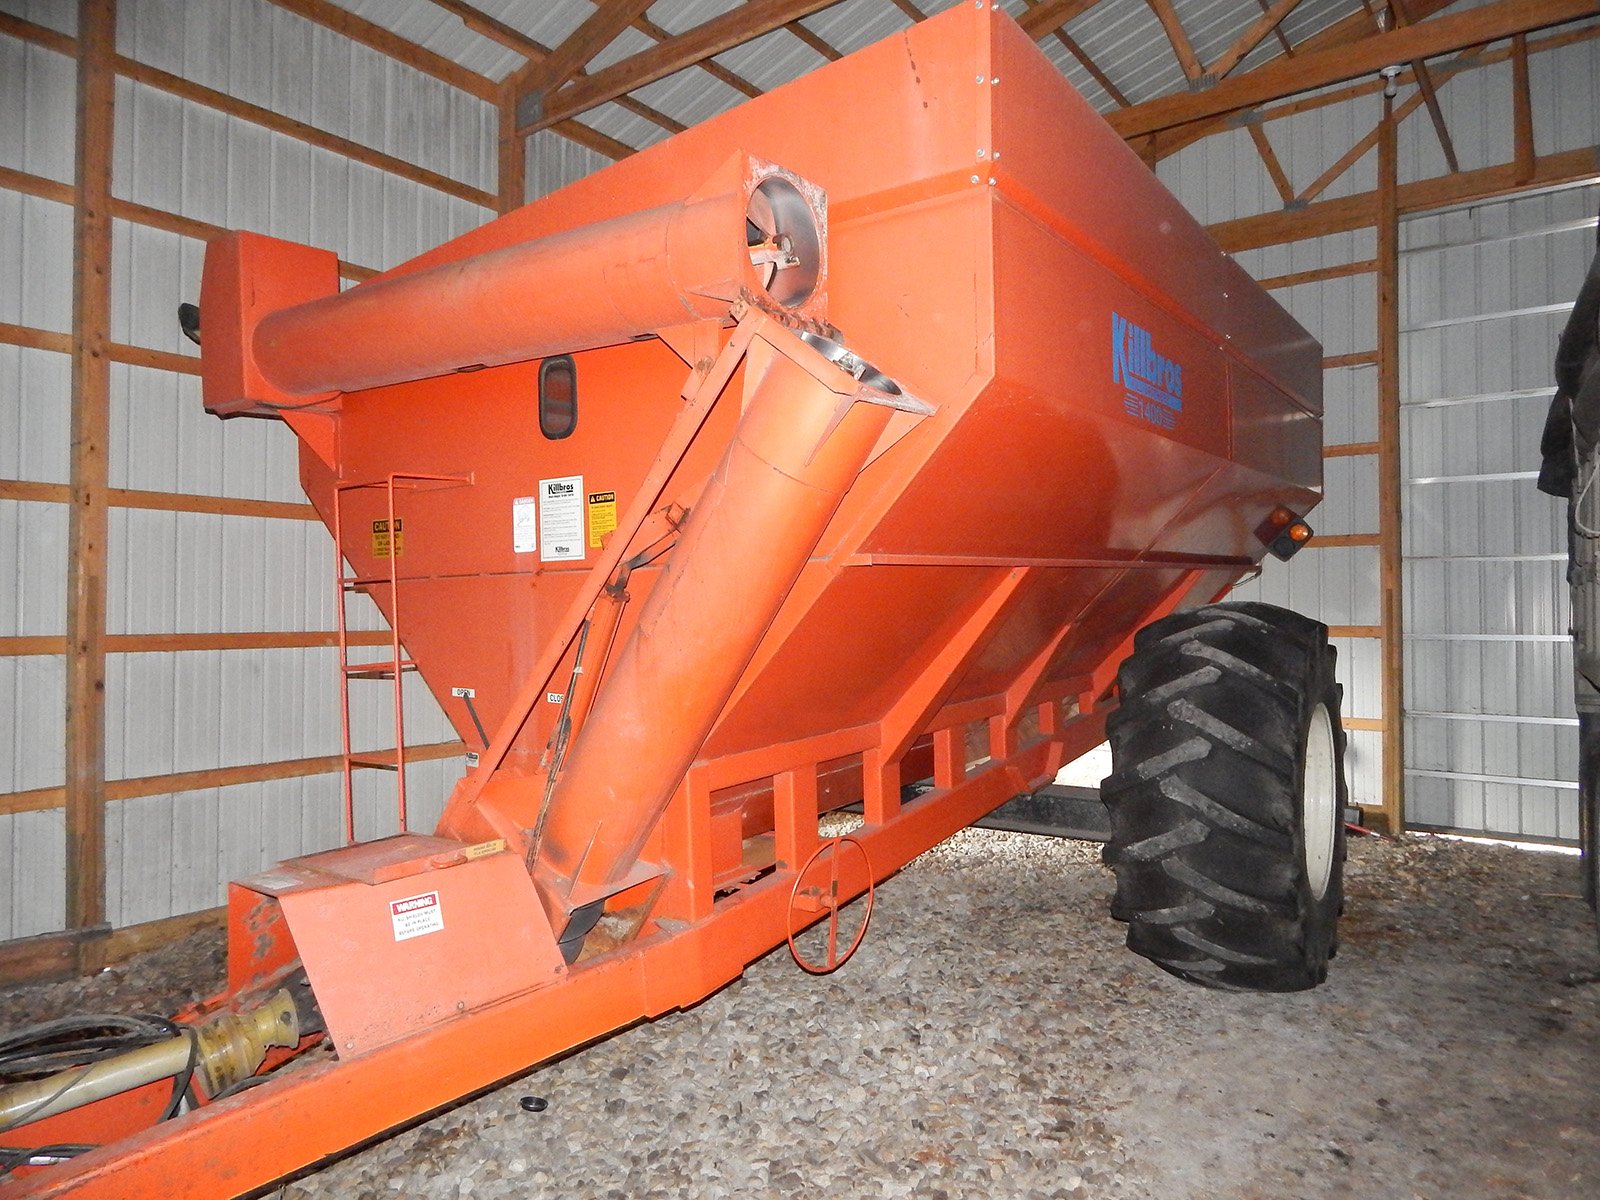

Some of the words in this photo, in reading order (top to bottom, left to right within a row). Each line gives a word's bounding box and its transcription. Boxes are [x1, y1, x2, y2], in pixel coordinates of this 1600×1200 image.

[1112, 311, 1182, 412] Killbros
[548, 483, 574, 495] Killbros
[596, 493, 614, 502] CAUTION
[375, 521, 400, 531] CAUTN
[396, 896, 434, 913] WARNING
